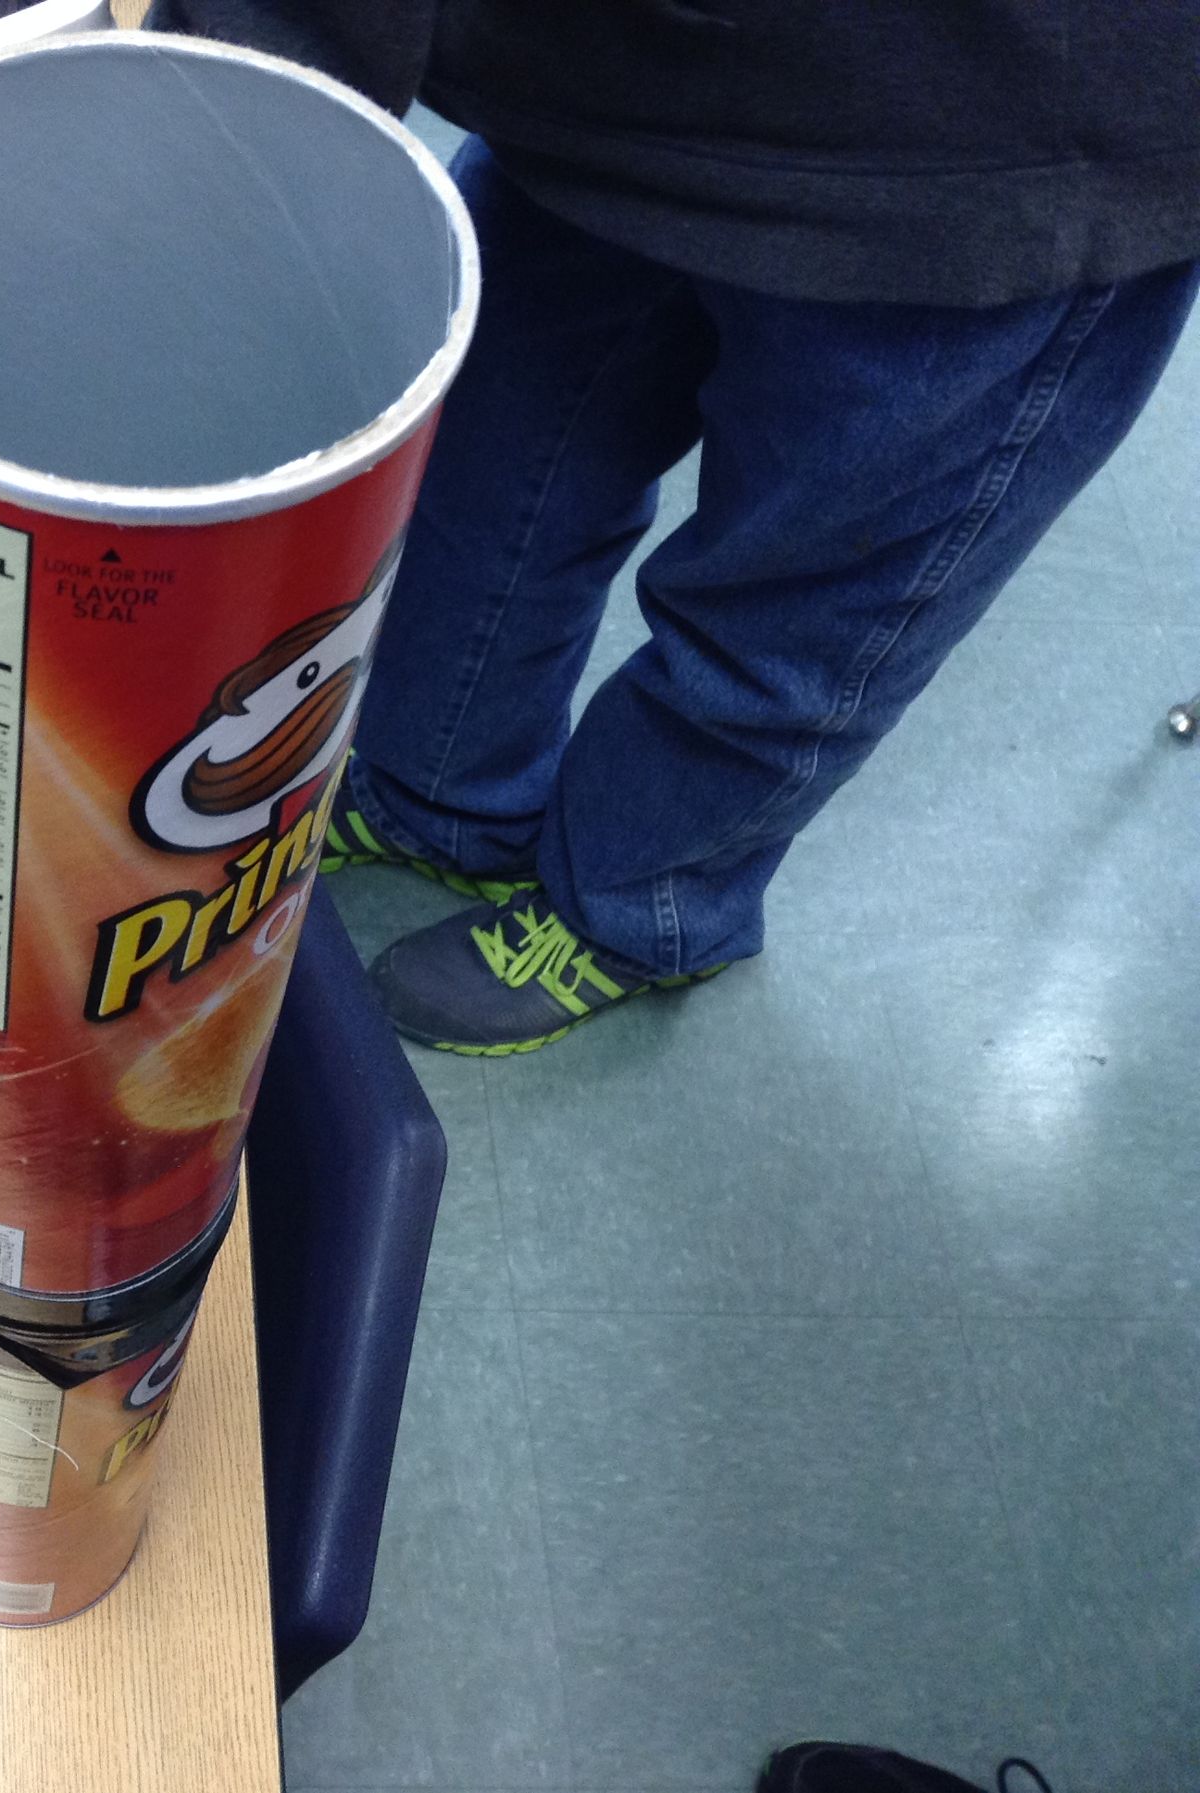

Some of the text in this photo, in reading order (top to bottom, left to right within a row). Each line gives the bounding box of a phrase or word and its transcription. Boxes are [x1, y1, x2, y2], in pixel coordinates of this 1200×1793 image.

[43, 557, 176, 584] LOOK FOR THE
[56, 578, 159, 605] FLAVOR
[73, 600, 136, 623] SEAL
